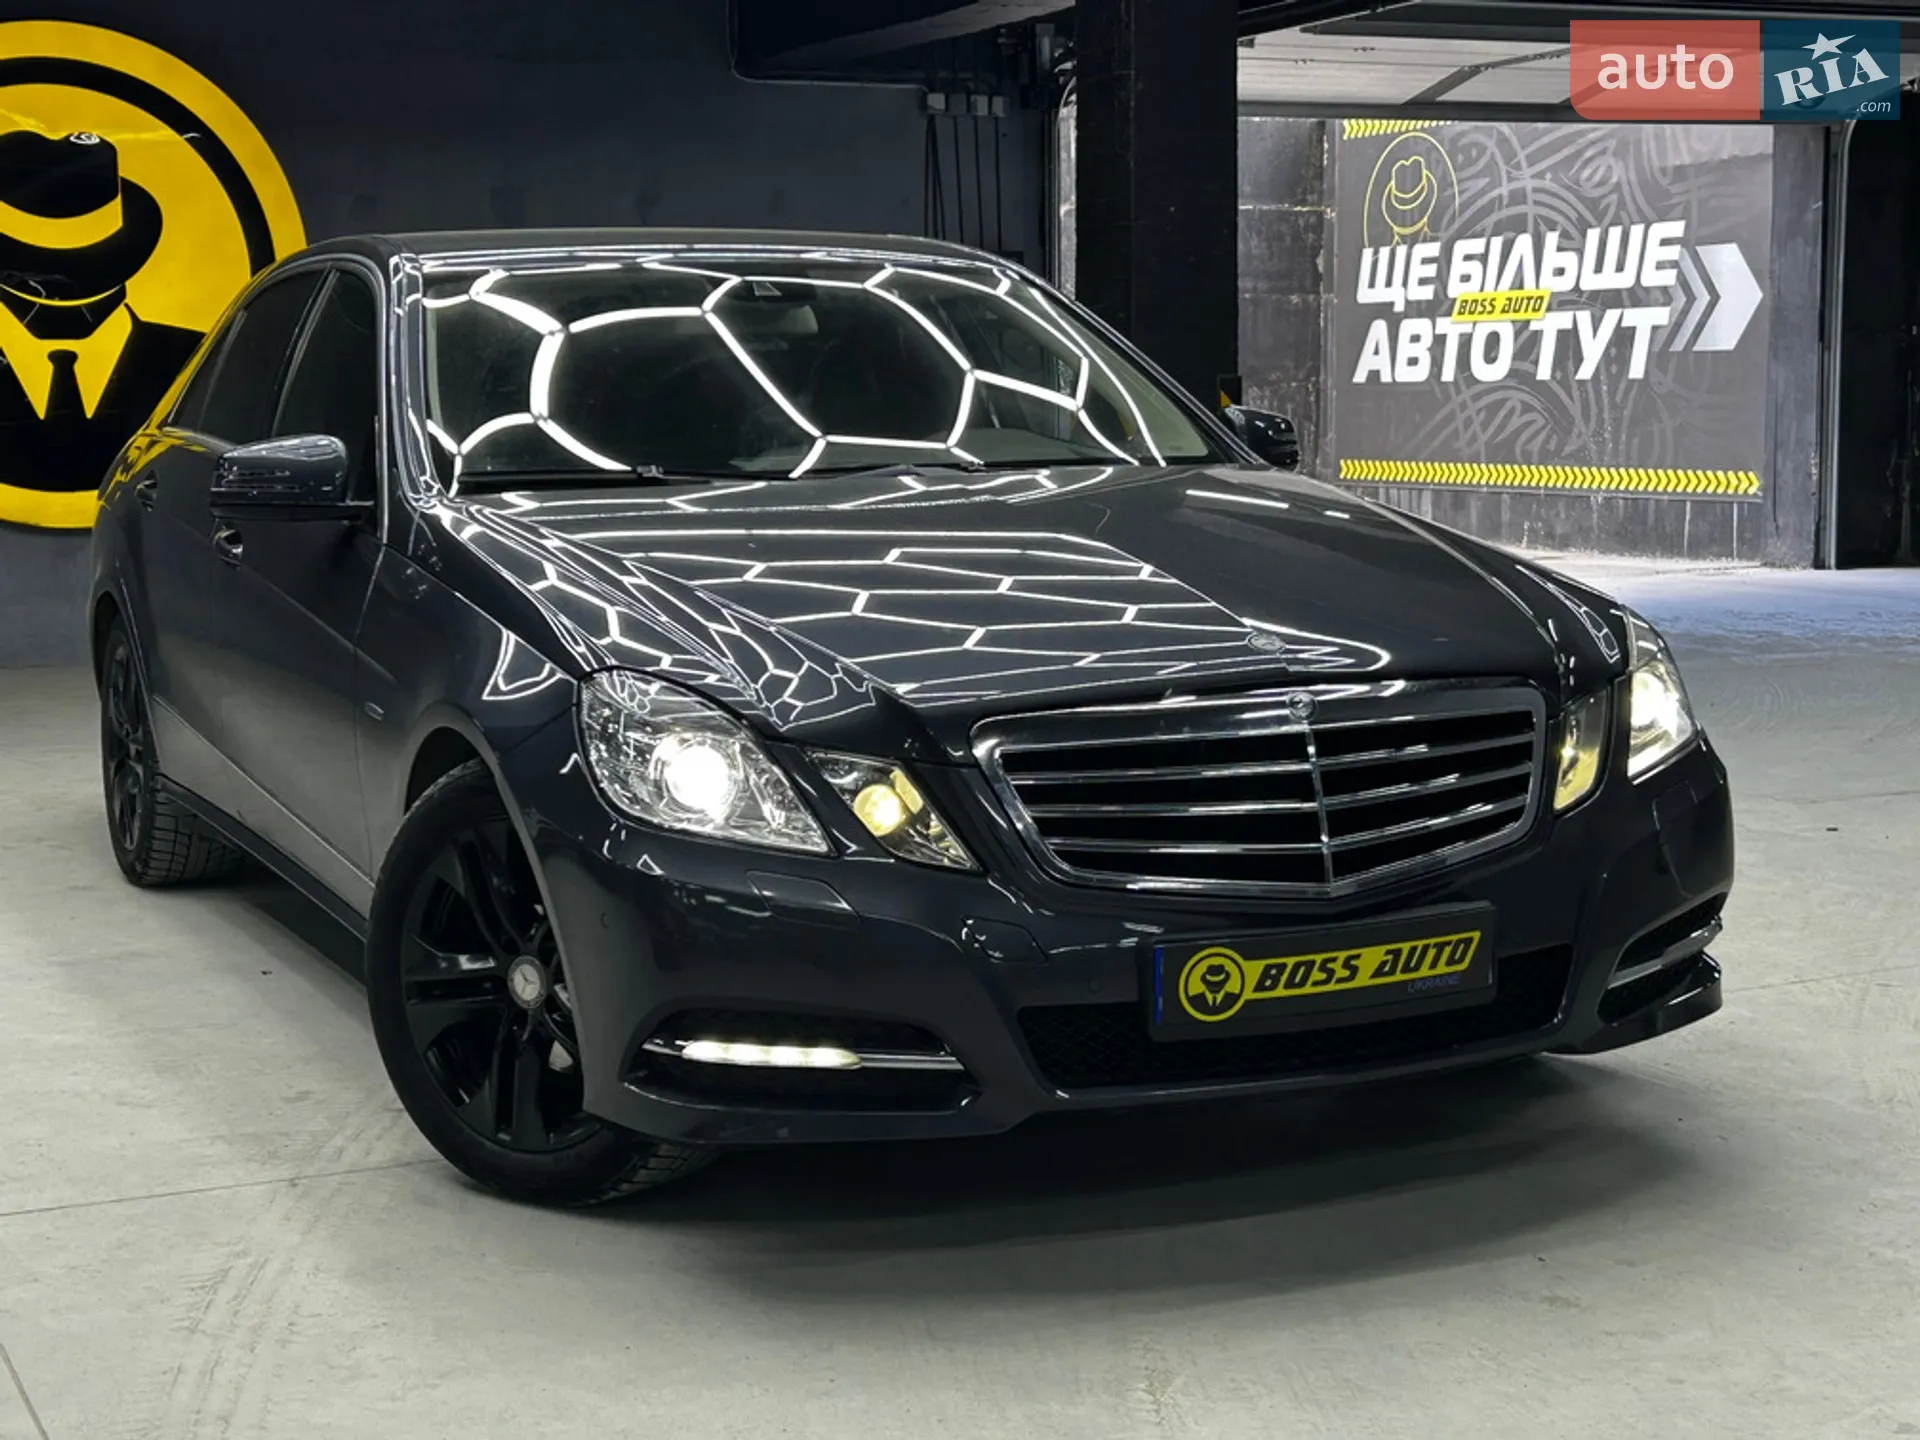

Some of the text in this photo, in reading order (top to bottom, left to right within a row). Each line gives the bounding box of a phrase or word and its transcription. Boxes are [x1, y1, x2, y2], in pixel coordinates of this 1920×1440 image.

[1356, 220, 1686, 313] ЩЕ БІЛЬШЕ
[1457, 295, 1545, 316] BOSS AUTO
[1352, 305, 1672, 384] АВТО ТУТ
[1253, 936, 1474, 993] BOSS AUTO
